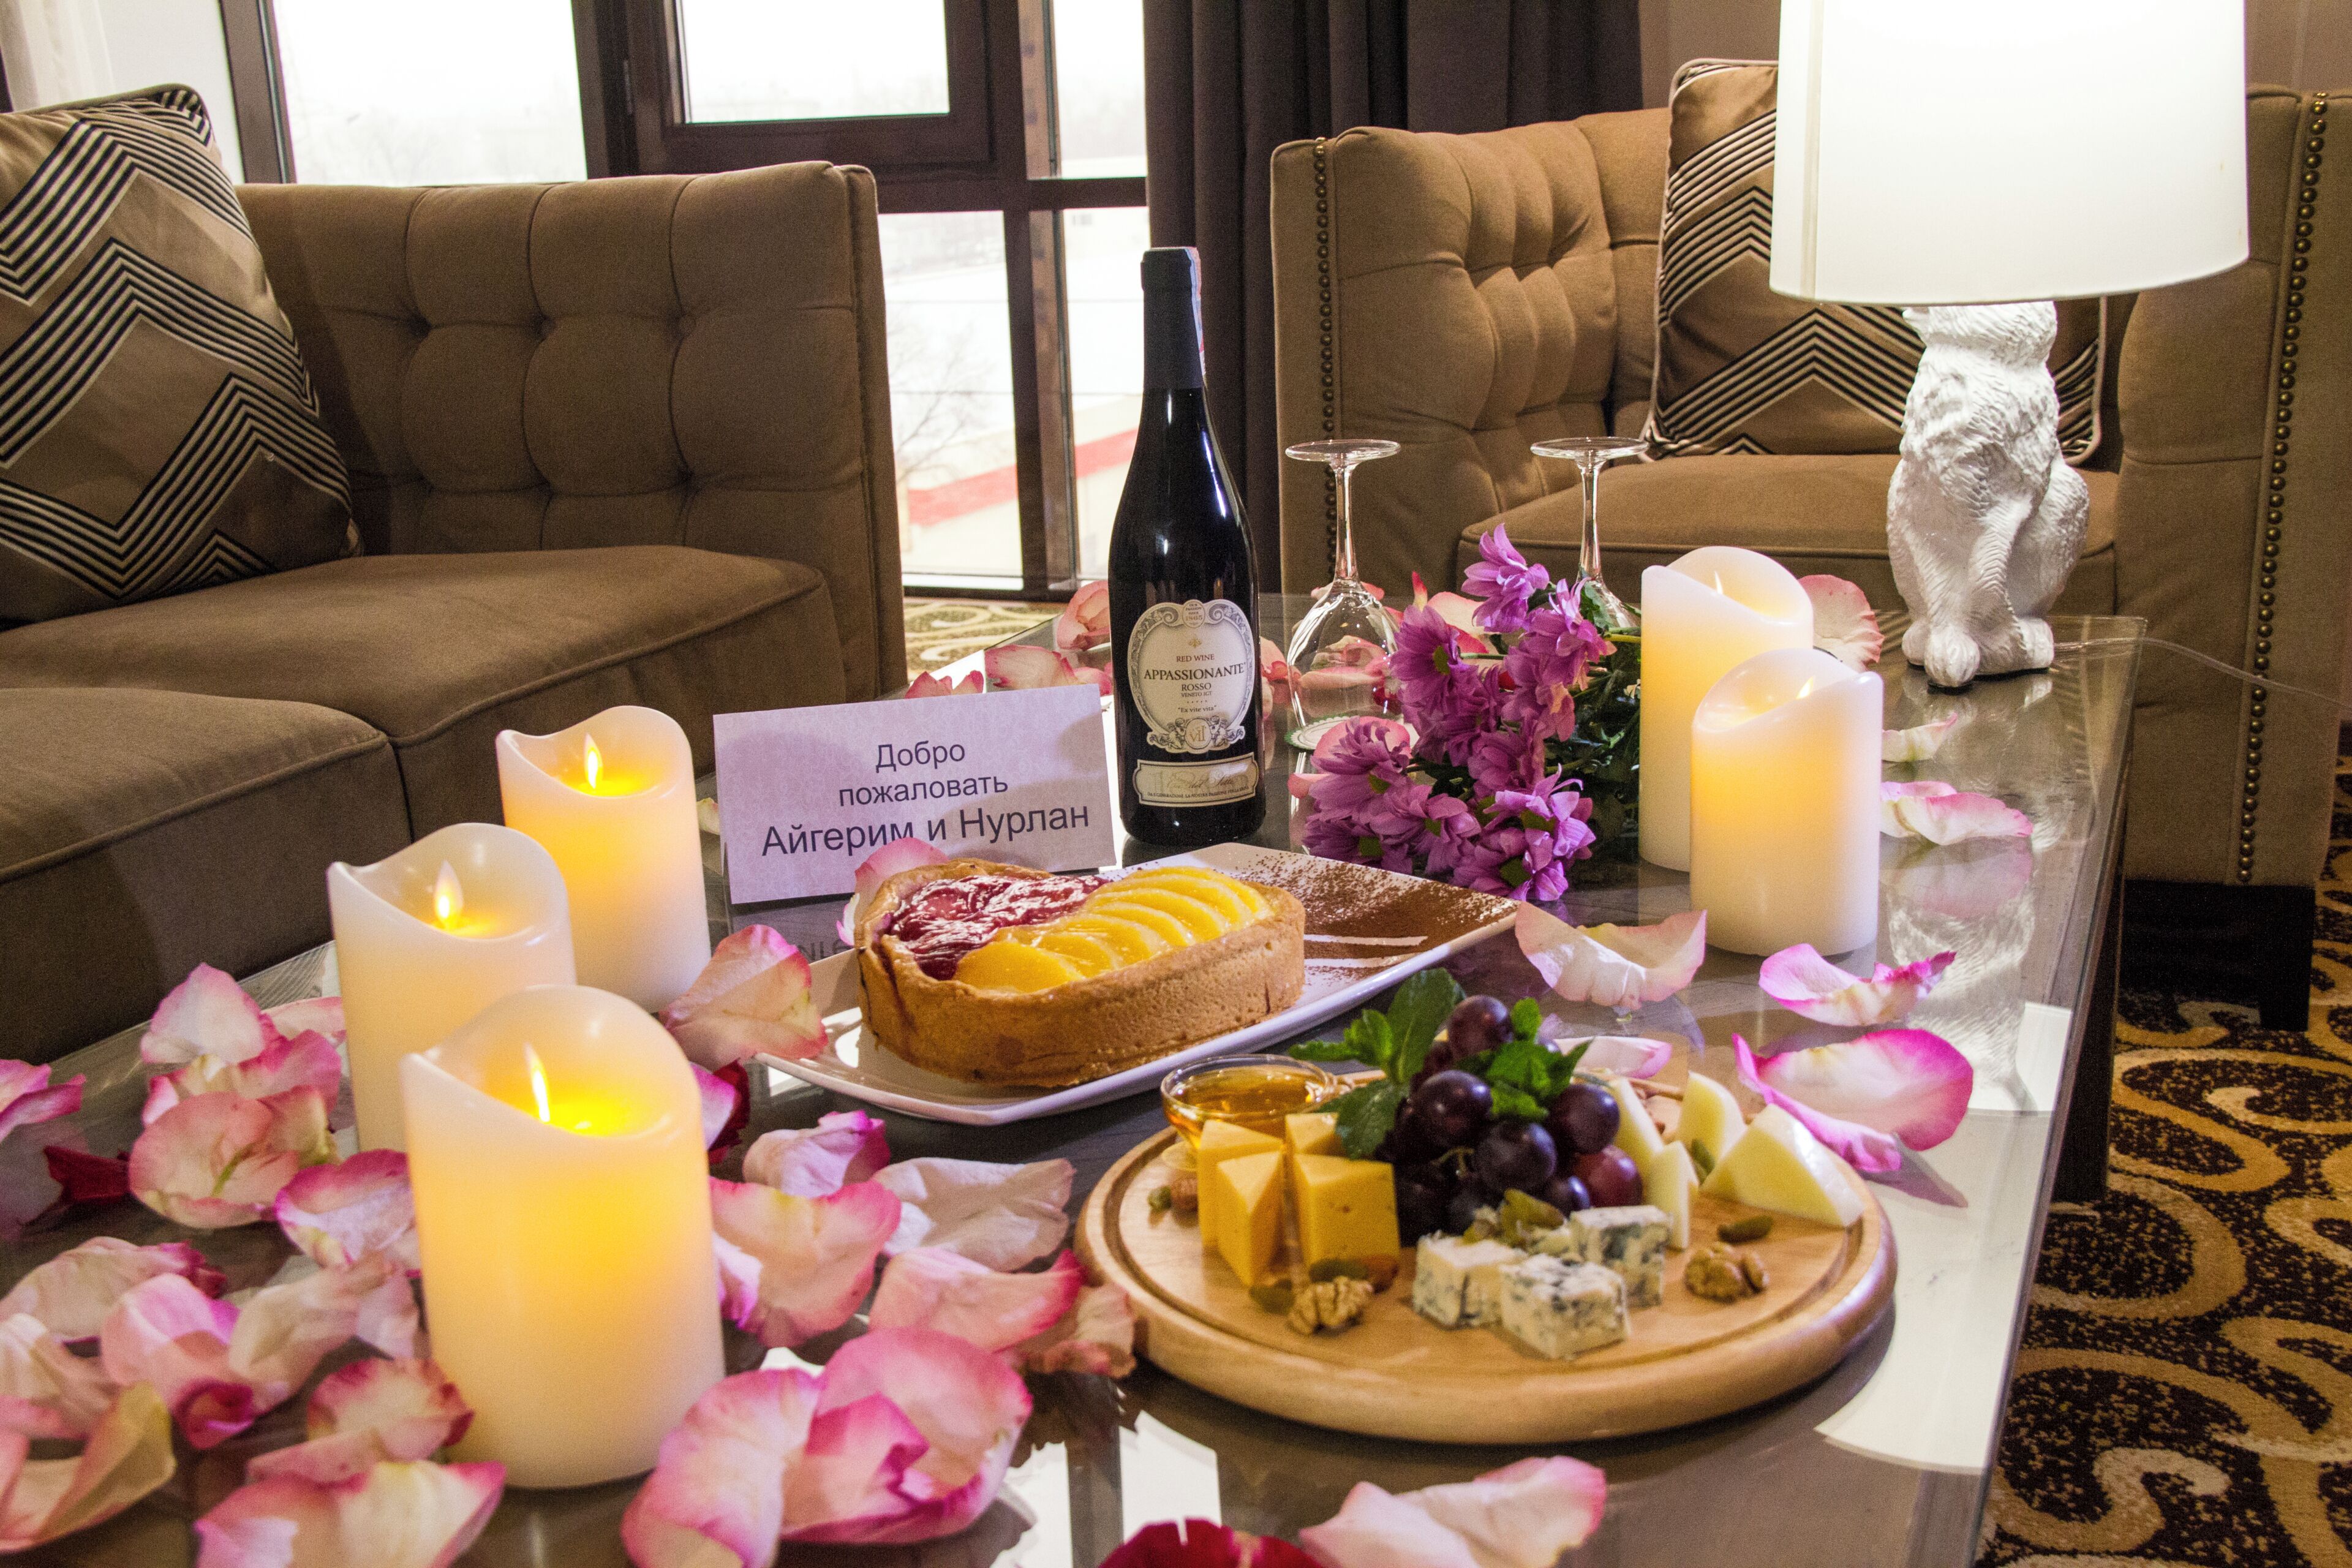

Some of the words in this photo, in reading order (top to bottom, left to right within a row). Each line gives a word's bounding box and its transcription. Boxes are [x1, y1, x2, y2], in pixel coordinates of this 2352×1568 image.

[1194, 654, 1215, 662] WINE
[1144, 663, 1245, 680] APPASSIONANTE
[1181, 682, 1212, 692] ROSSO
[875, 740, 965, 774] Добро
[839, 775, 1008, 807] пожаловать
[761, 821, 913, 856] Айгерим
[927, 818, 947, 841] и
[959, 805, 1089, 844] Нурлан
